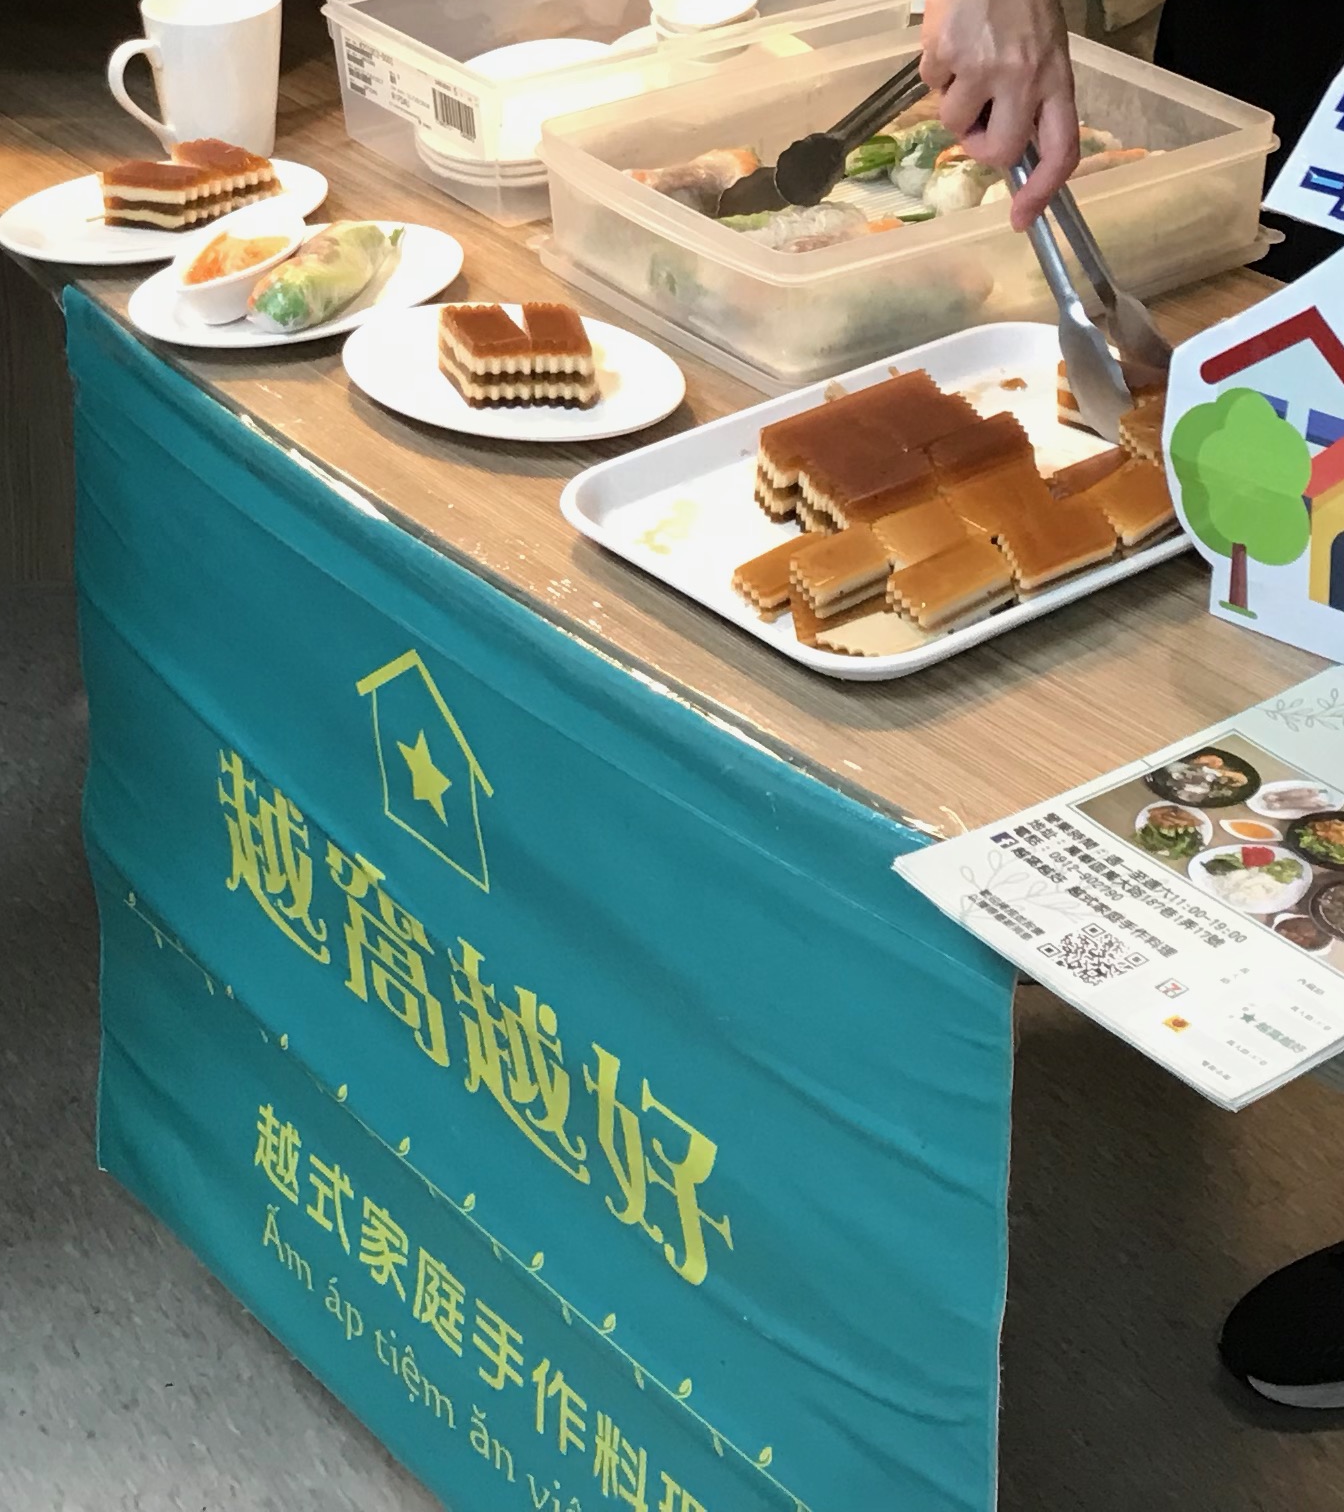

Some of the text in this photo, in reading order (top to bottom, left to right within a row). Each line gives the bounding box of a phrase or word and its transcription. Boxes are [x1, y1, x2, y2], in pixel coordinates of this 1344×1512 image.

[217, 748, 735, 1286] 越窩越好
[323, 1276, 364, 1341] áp
[374, 1328, 457, 1429] tiệm
[468, 1403, 516, 1483] ăn
